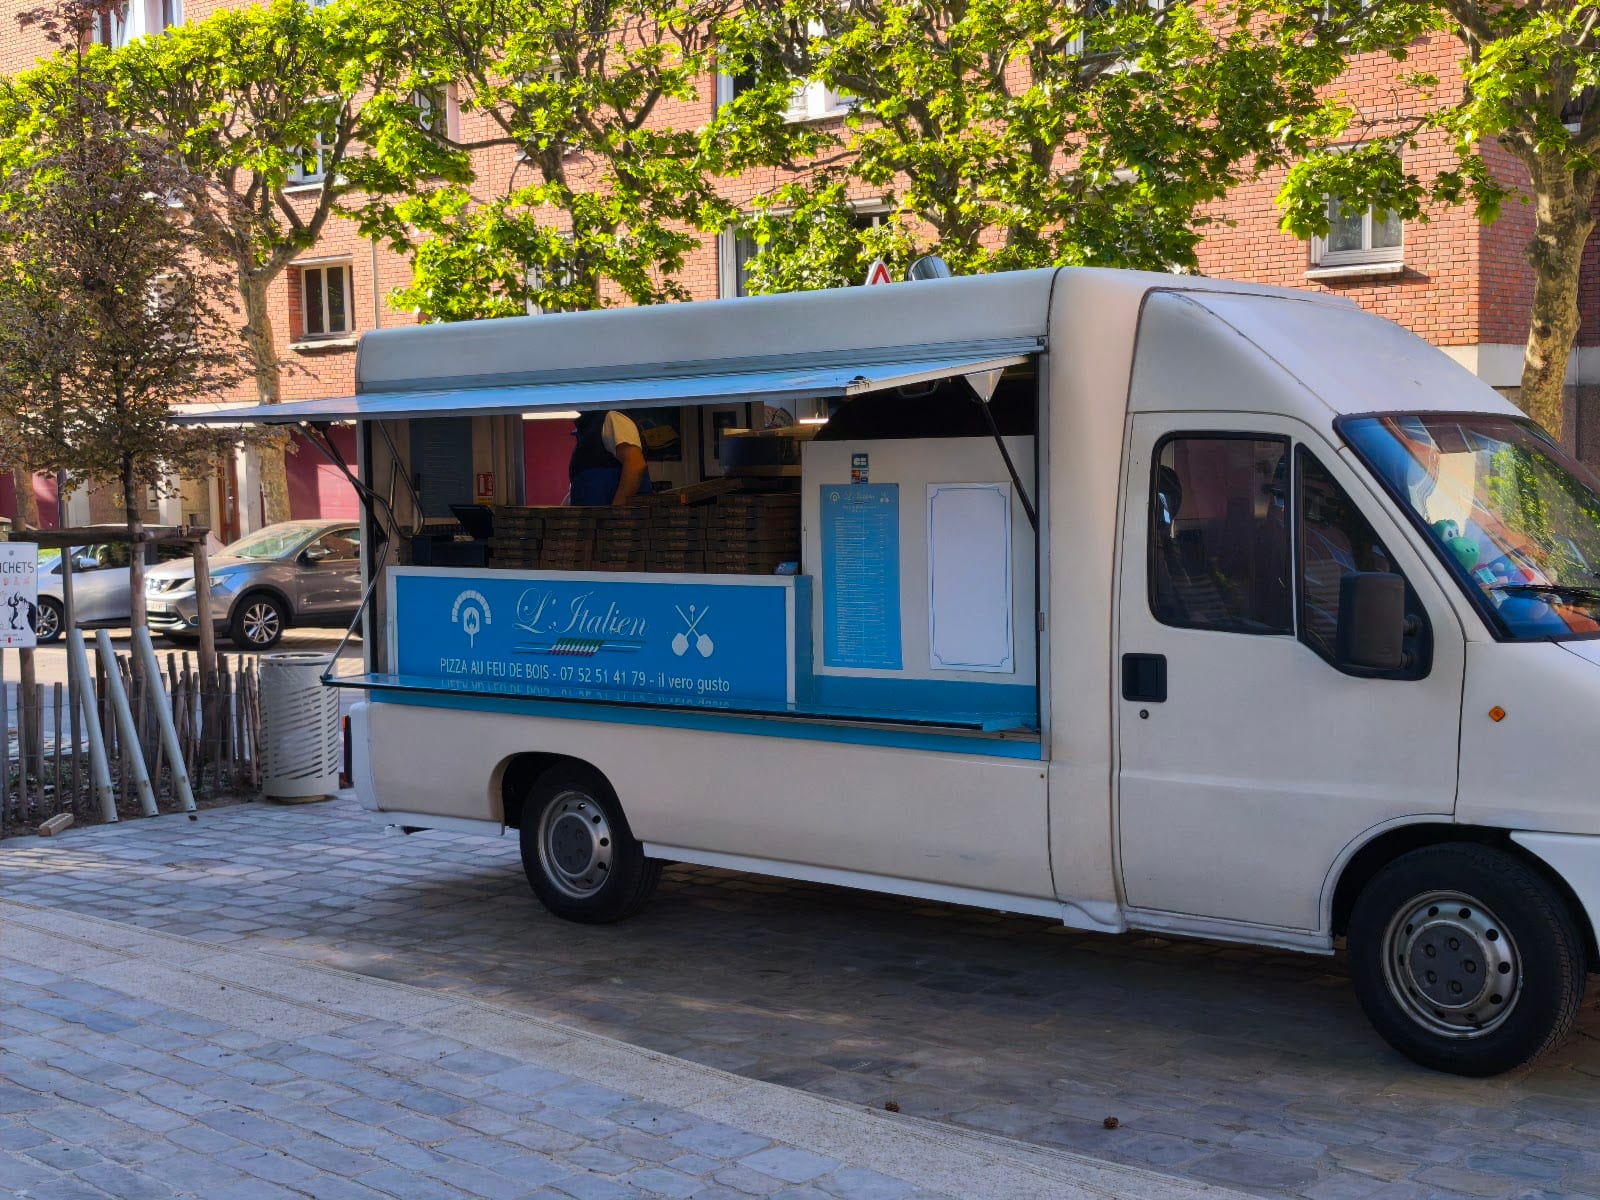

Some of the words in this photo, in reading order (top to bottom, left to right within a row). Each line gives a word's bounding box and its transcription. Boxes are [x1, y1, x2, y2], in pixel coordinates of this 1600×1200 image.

[440, 657, 468, 674] PIZZA
[470, 660, 484, 675] AU
[486, 661, 506, 677] FEU
[509, 662, 523, 678] DE
[525, 663, 549, 680] BOIS
[560, 666, 574, 681] 07
[578, 667, 592, 683] 52
[595, 668, 608, 684] 51
[613, 669, 626, 685] 41
[631, 670, 646, 686] 79
[658, 672, 665, 688] il
[668, 676, 694, 690] vero
[697, 677, 730, 695] gusto
